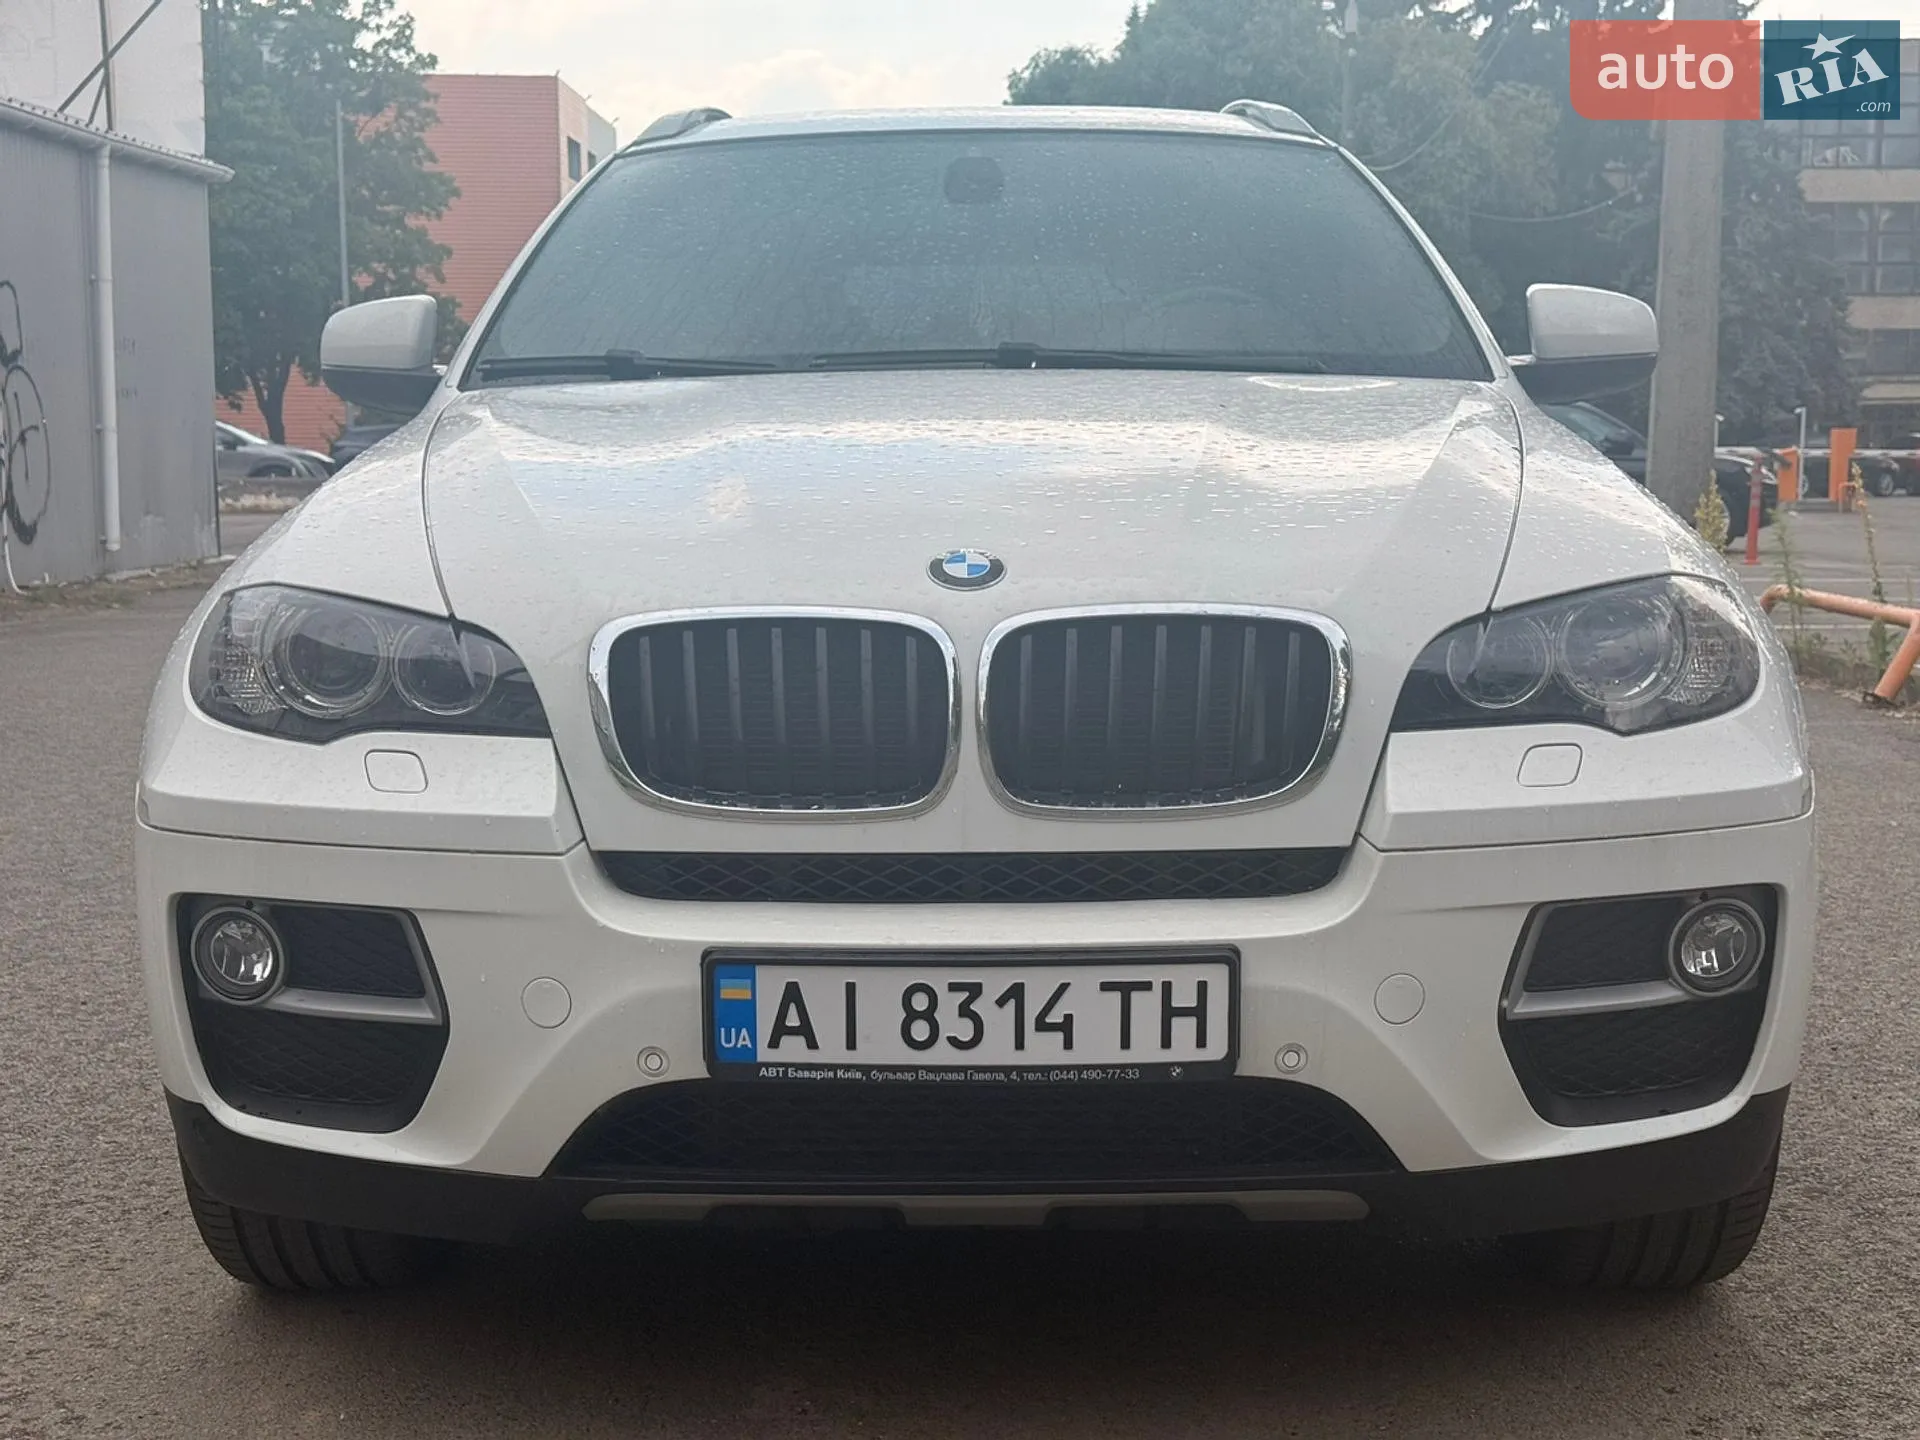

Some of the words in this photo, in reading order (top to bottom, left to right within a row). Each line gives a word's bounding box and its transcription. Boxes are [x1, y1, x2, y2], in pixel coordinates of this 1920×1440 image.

[766, 981, 857, 1050] AI
[900, 981, 1074, 1051] 8314
[1099, 980, 1208, 1050] TH
[720, 1027, 752, 1049] UA
[788, 1067, 834, 1080] Баварія
[837, 1068, 866, 1081] Київ,
[870, 1070, 916, 1082] бульвар
[918, 1069, 965, 1082] Вацлава
[967, 1070, 1008, 1082] Гавела,
[1010, 1070, 1020, 1082] 4,
[1050, 1070, 1078, 1081] (044)
[1080, 1069, 1140, 1080] 490-77-33
